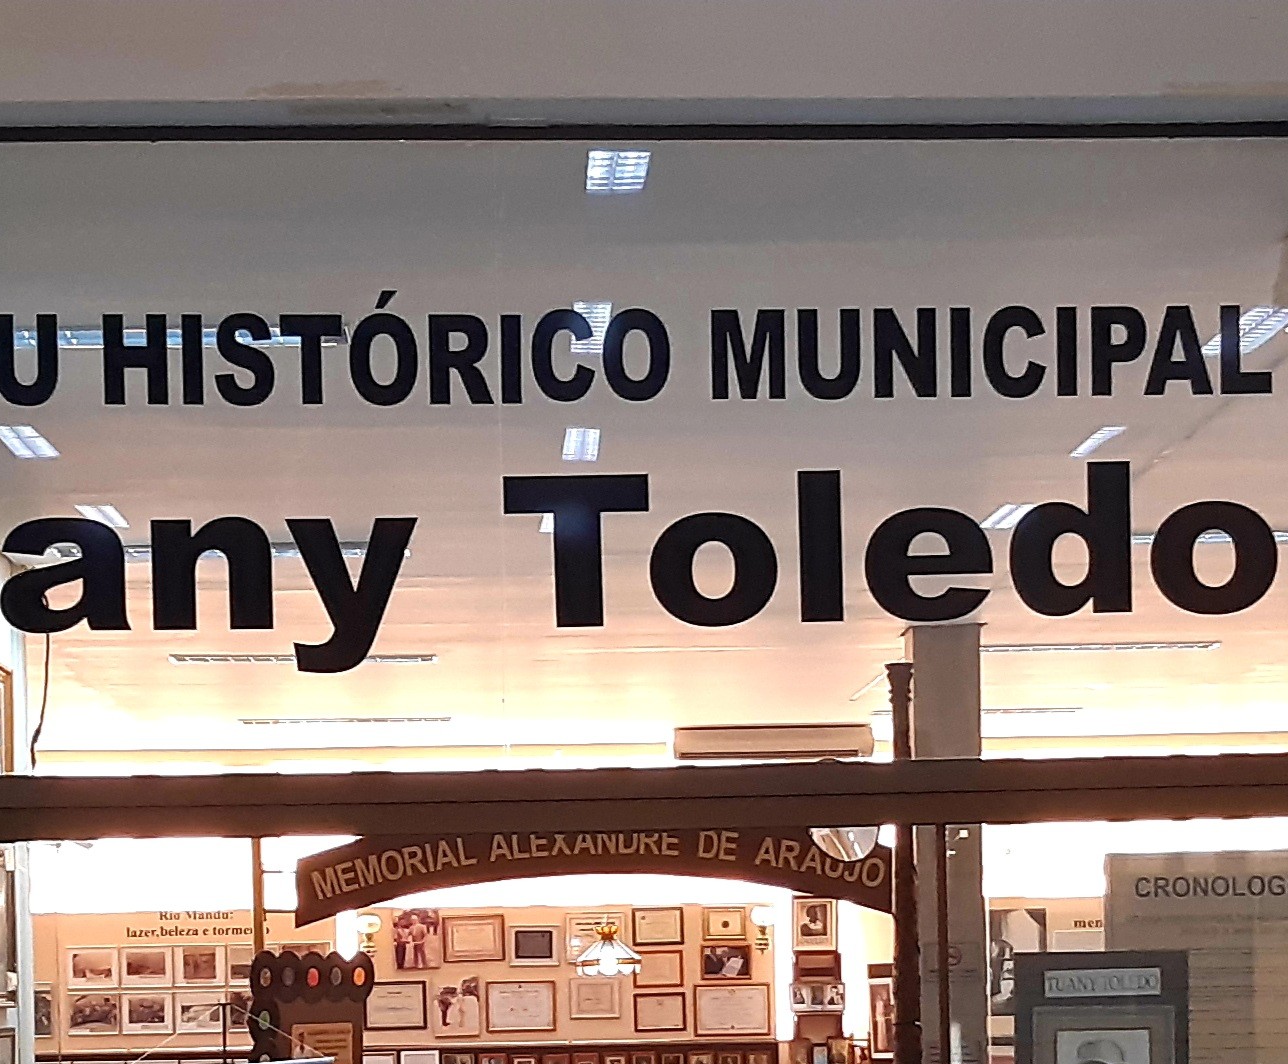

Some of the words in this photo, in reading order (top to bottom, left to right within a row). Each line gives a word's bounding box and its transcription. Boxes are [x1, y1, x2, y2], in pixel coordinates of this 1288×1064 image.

[103, 290, 670, 406] HISTÓRICO
[711, 304, 1274, 400] MUNICIPAL
[503, 461, 1279, 627] Toledo
[311, 837, 478, 900] MEMORIAL
[488, 832, 680, 862] ALEXANDRE
[697, 830, 739, 861] DE
